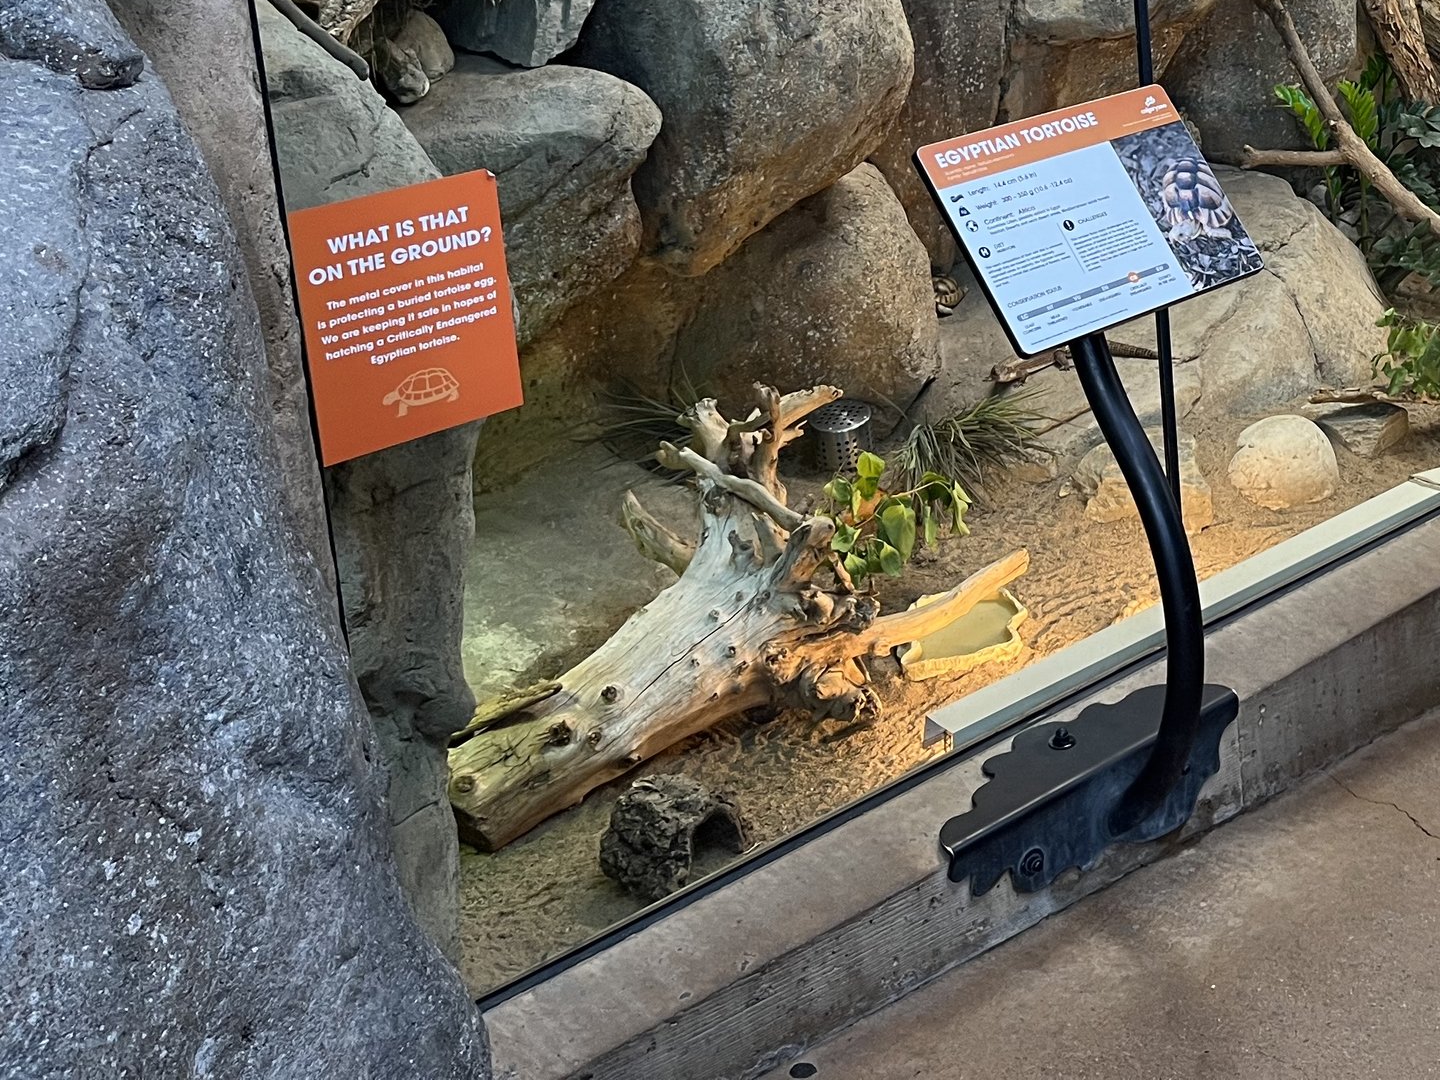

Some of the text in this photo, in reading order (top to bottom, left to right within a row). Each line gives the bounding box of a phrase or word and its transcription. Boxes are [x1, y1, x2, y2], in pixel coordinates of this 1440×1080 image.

[935, 133, 1020, 168] EGYPTIAN
[1020, 112, 1098, 143] TORTOISE
[967, 185, 990, 196] Length:
[975, 199, 998, 211] Weight:
[983, 211, 1014, 224] Continent:
[1016, 204, 1036, 214] Africa
[327, 206, 468, 254] WHAT IS THAT
[309, 226, 491, 285] ON THE GROUND?
[327, 300, 346, 310] The
[349, 289, 380, 304] metal
[383, 282, 412, 295] cover
[427, 274, 445, 284] this
[447, 263, 483, 278] habitat
[329, 306, 384, 328] protecting
[397, 292, 431, 308] buried
[434, 283, 471, 298] tortoise
[474, 277, 496, 288] egg.
[321, 290, 496, 344] We are keeping it safe in hopes of
[326, 342, 374, 360] hatching
[387, 325, 433, 343] Critically
[436, 306, 497, 329] Endangered
[371, 335, 460, 364] Egyptian tortoise.
